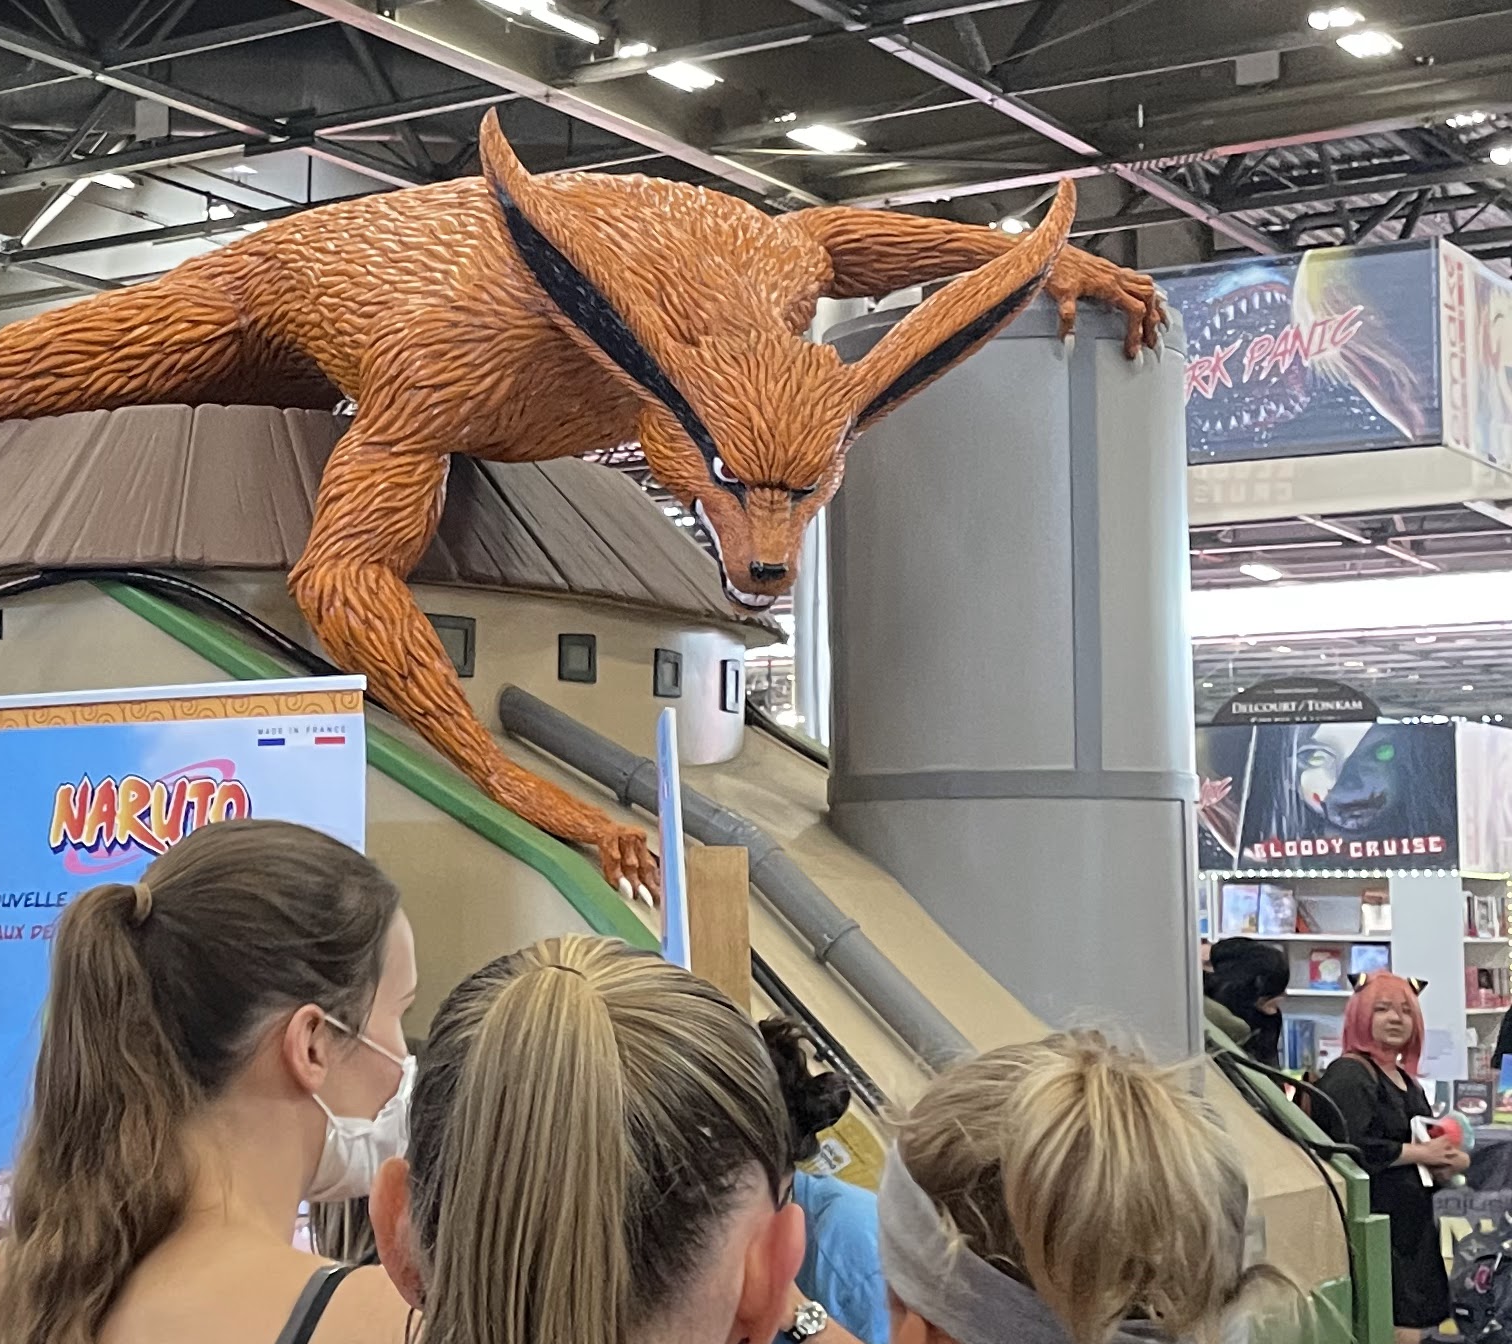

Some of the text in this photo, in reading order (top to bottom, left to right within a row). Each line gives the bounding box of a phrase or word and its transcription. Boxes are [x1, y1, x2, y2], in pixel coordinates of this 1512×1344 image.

[1242, 304, 1364, 383] PANIC
[257, 727, 283, 735] MADE
[306, 725, 346, 734] FRANCE
[49, 773, 252, 856] NARUTO
[1253, 836, 1443, 859] BLOODY CRUISE
